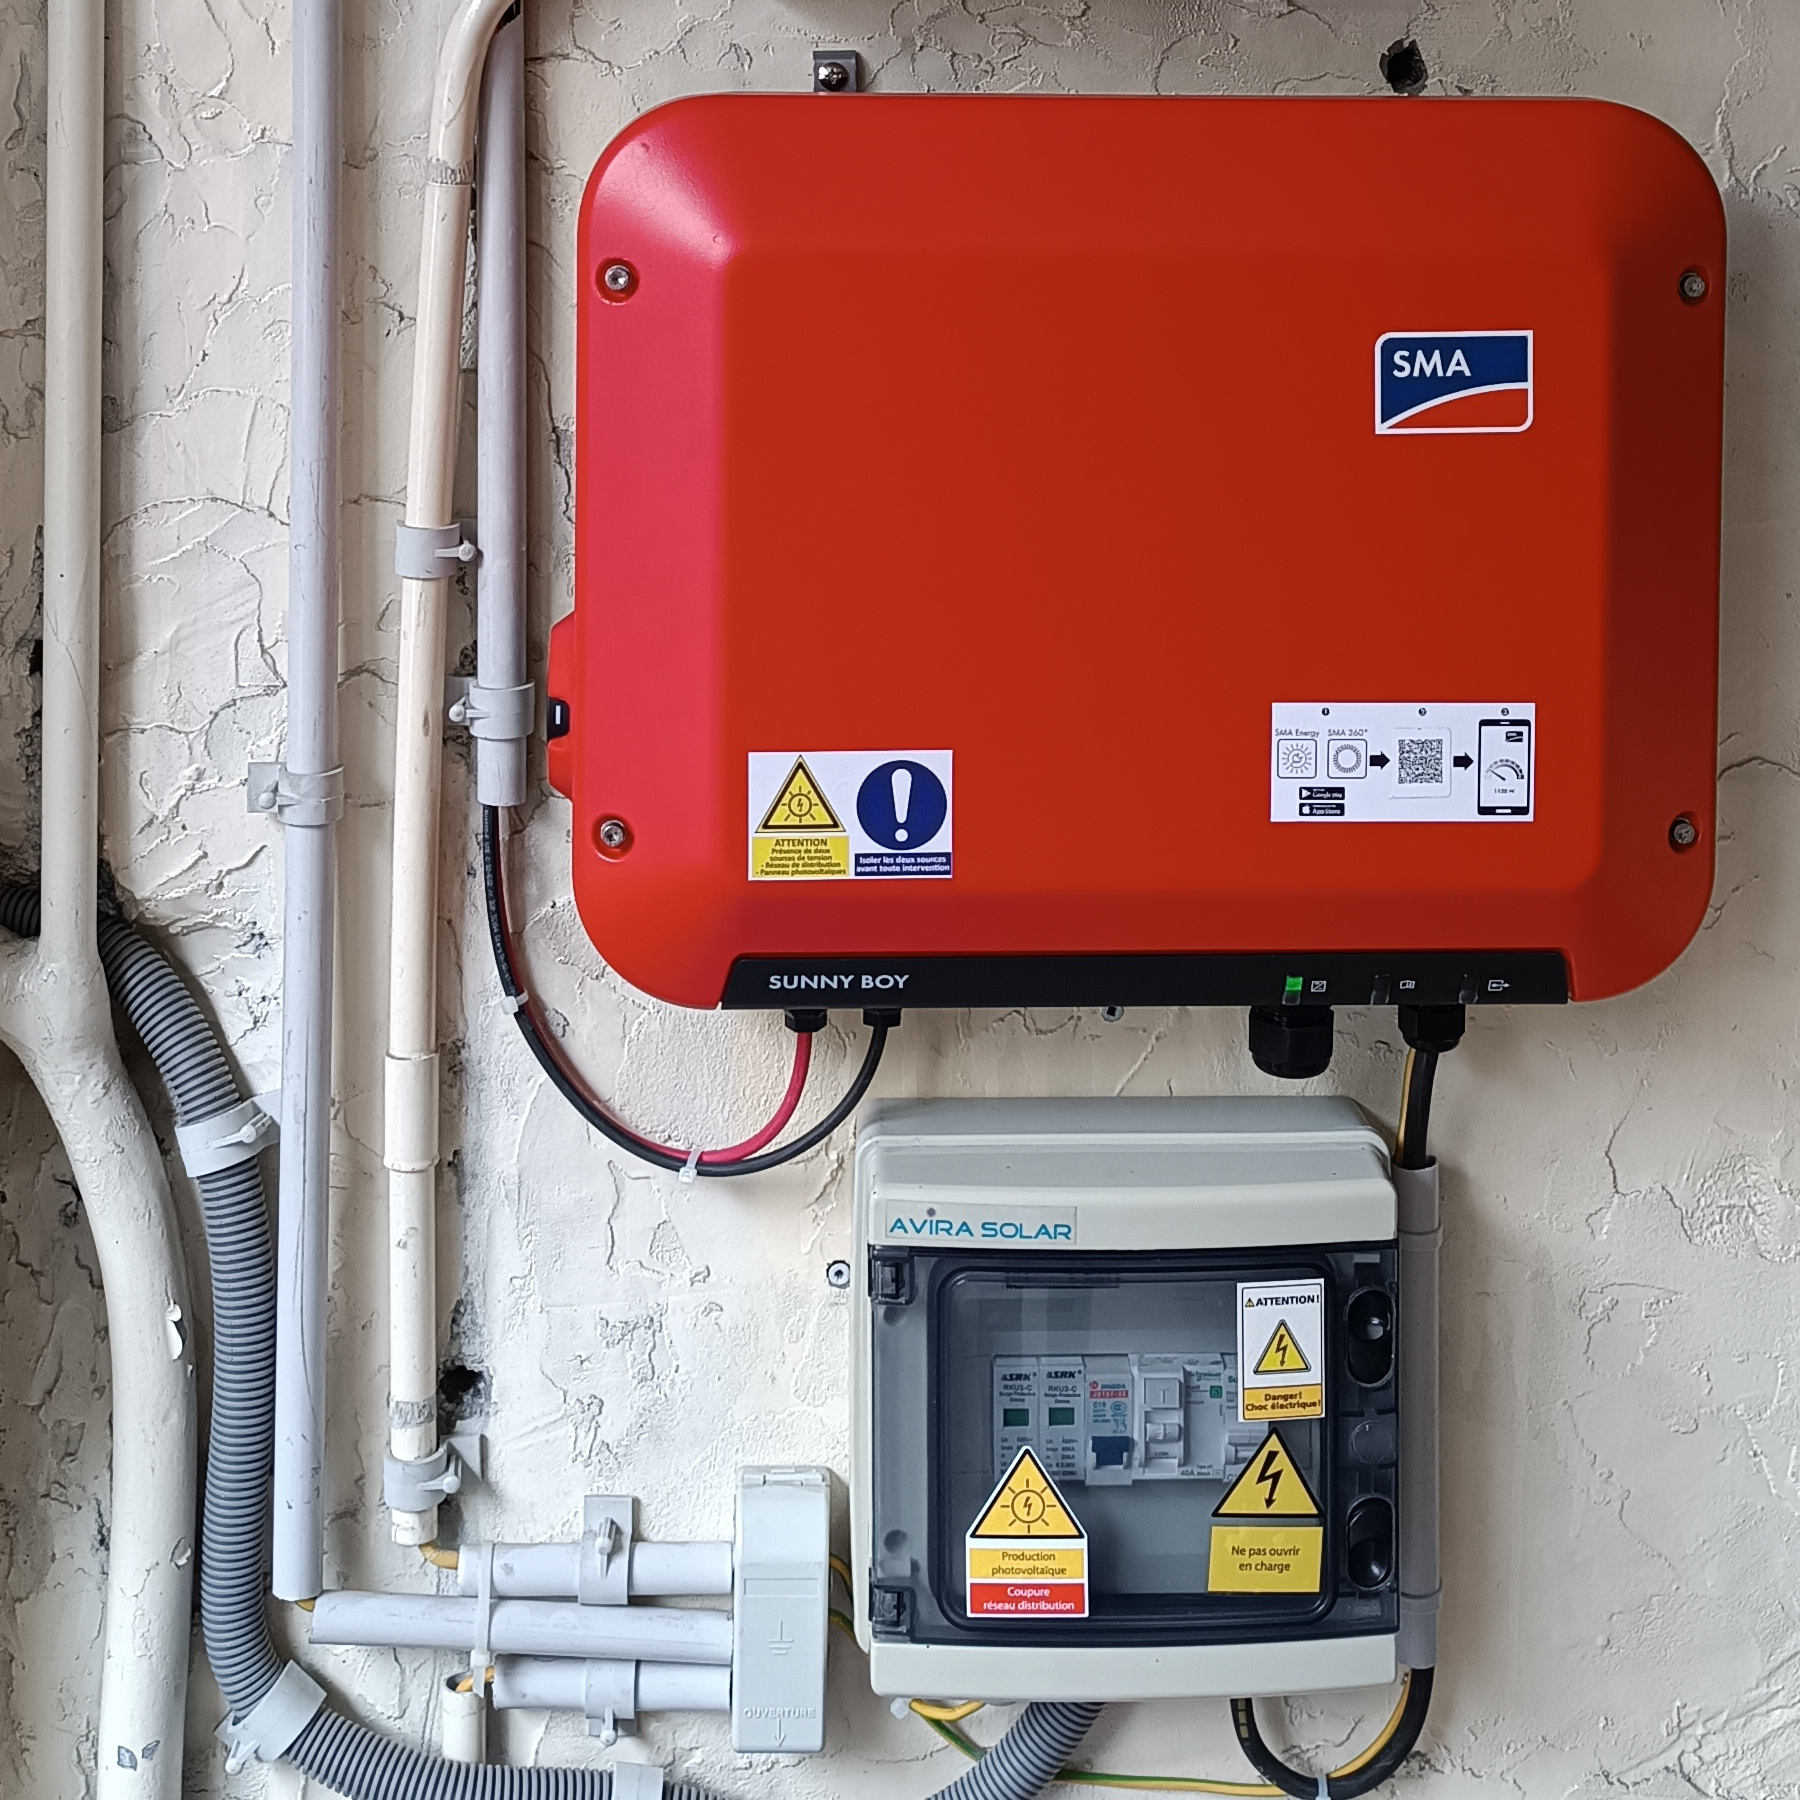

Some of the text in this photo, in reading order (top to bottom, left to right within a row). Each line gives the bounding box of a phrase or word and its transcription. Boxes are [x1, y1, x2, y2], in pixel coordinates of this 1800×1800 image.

[1392, 349, 1472, 378] SMA
[1274, 728, 1320, 738] SMA Energy
[1327, 728, 1346, 737] SMA
[774, 838, 828, 847] ATTENTION
[859, 856, 881, 864] Isoler
[882, 856, 894, 864] les
[895, 855, 915, 863] deux
[902, 864, 950, 872] intervention
[768, 974, 910, 989] SUNNY BOY
[889, 1216, 1072, 1240] AVIRA SOLAR
[1245, 1403, 1268, 1412] Choc
[1001, 1551, 1056, 1561] Production
[1231, 1545, 1301, 1558] Ne pas ouvrir
[991, 1564, 1067, 1577] photovoltaïque
[1238, 1560, 1291, 1574] en charge
[1007, 1586, 1051, 1598] Coupure
[983, 1600, 1075, 1610] réseau distribution
[743, 1706, 817, 1719] OUVERTURE
